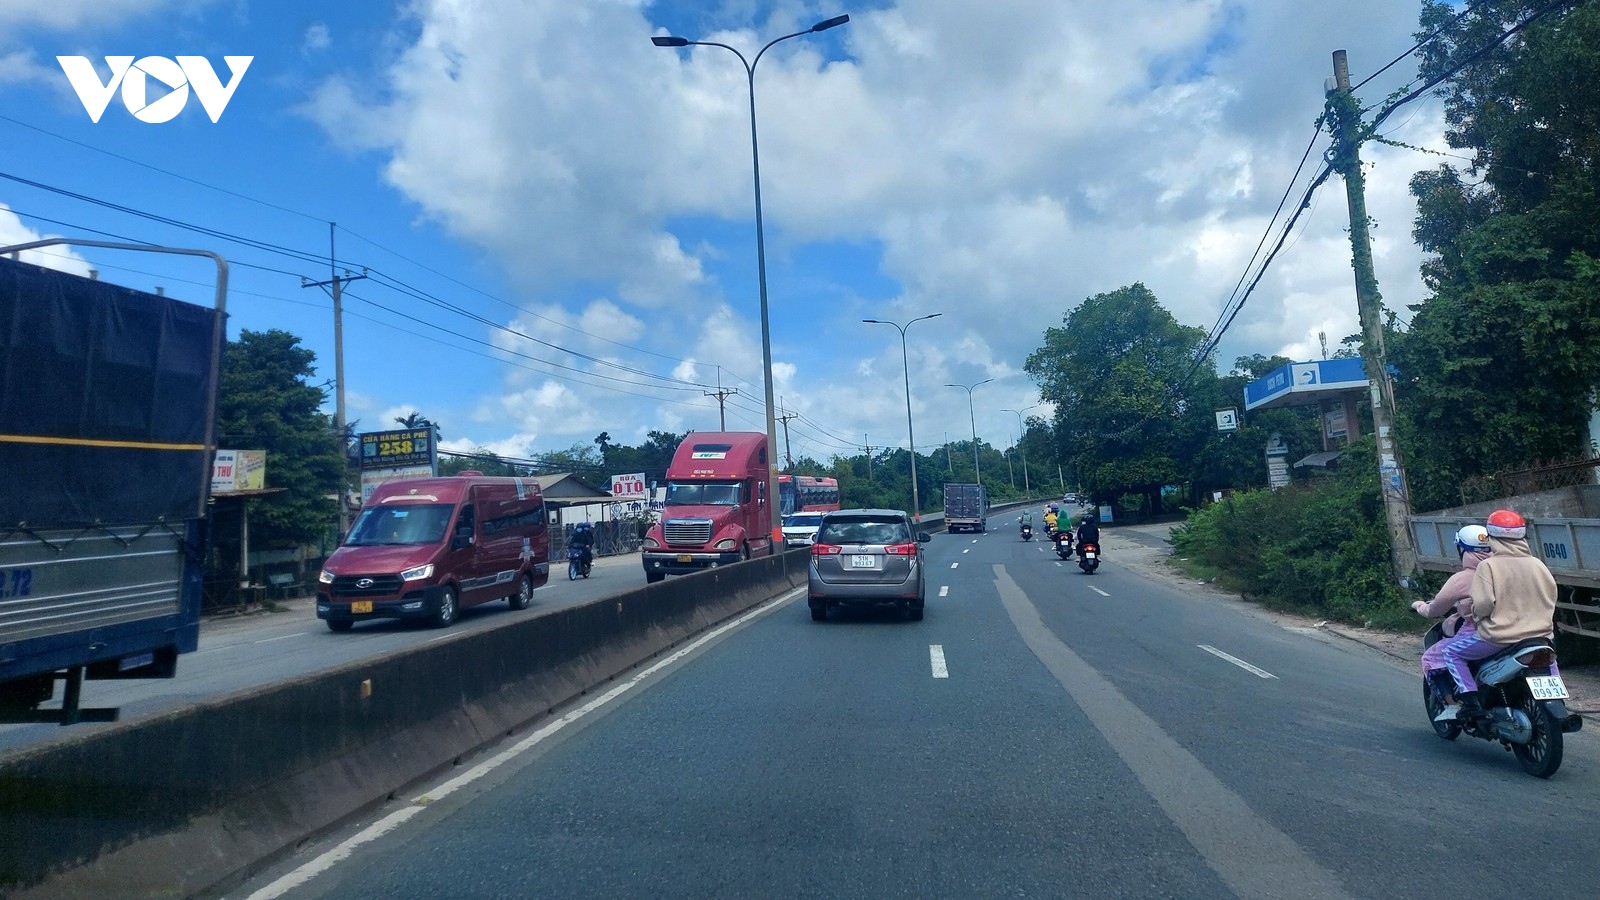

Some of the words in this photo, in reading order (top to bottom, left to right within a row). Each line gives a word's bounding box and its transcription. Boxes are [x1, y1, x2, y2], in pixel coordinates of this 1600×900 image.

[380, 432, 400, 441] HÀNG
[380, 441, 413, 456] 258
[1543, 542, 1567, 559] 0640
